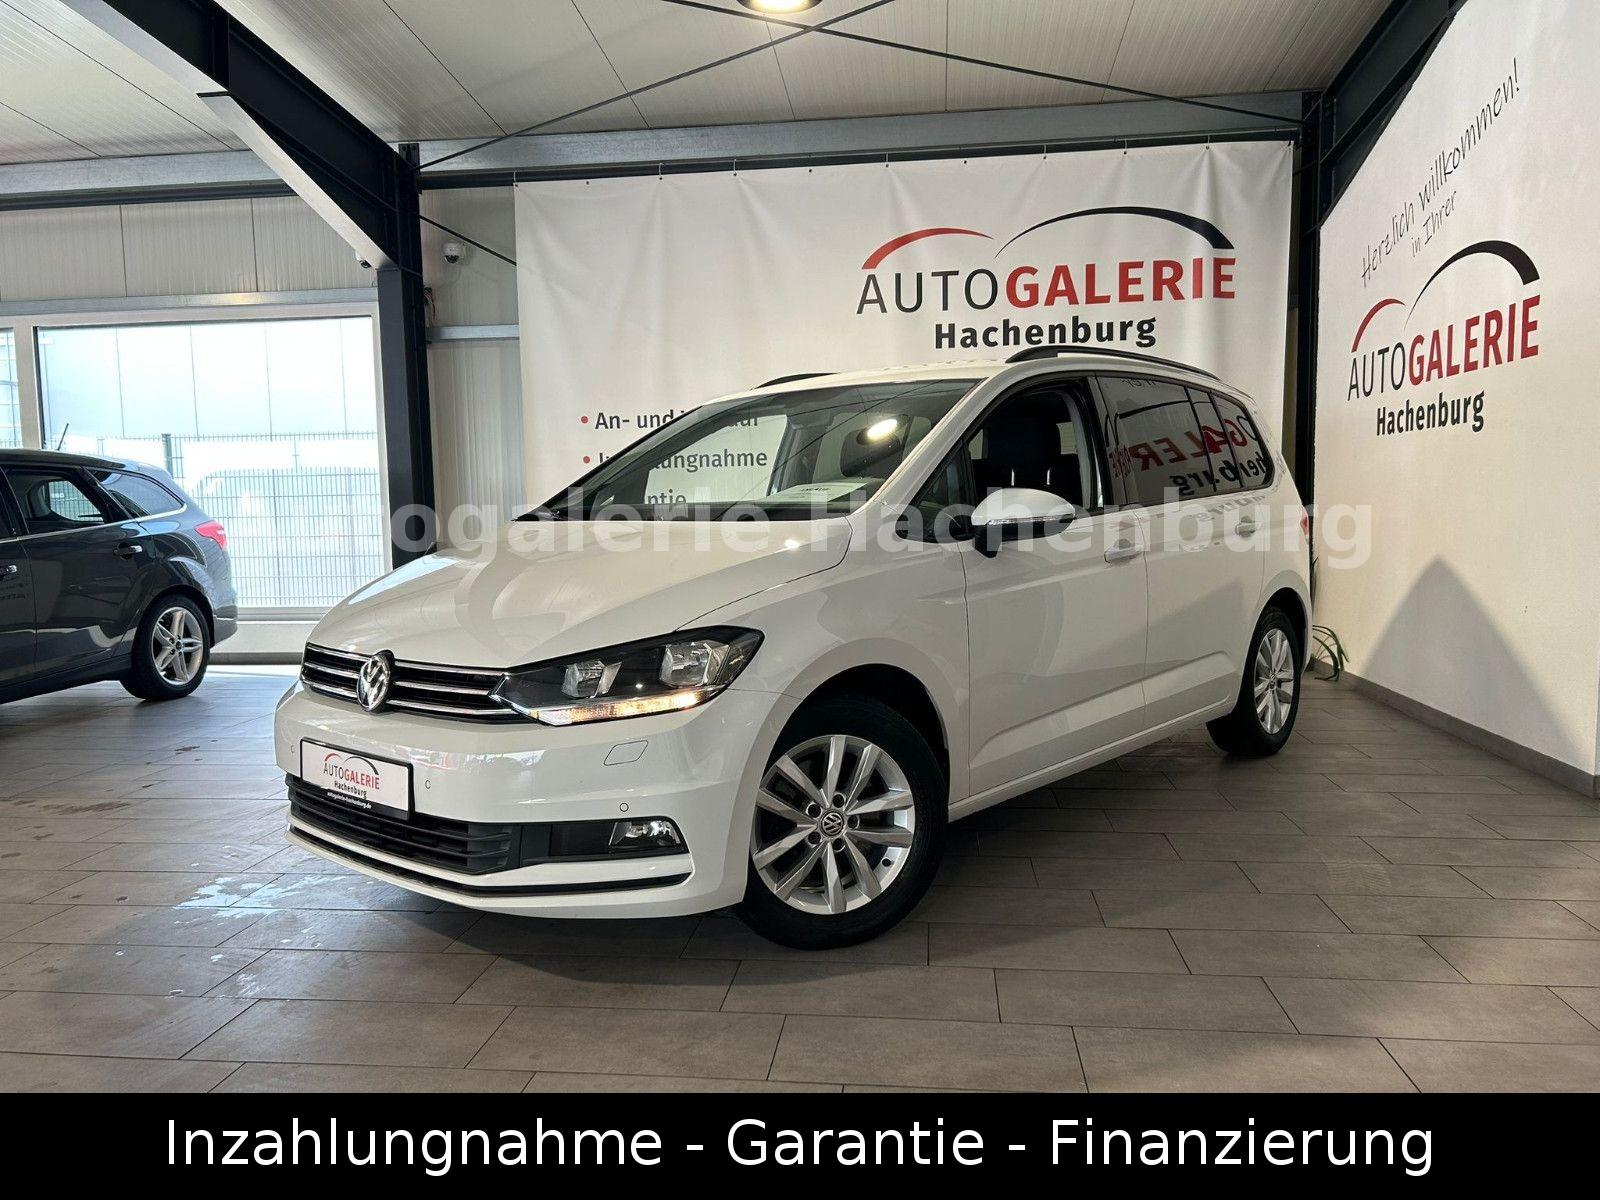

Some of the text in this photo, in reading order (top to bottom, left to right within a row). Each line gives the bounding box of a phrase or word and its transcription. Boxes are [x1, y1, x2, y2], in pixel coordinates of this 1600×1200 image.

[1362, 57, 1520, 287] Herzlich willkommen!
[1411, 190, 1457, 258] in Ihrer
[856, 257, 1236, 315] AUTOGALERIE
[935, 316, 1156, 349] Hachenburg
[1347, 294, 1540, 401] AUTOGALERIE
[595, 412, 629, 429] An-
[1376, 389, 1485, 436] Hachenburg
[323, 762, 380, 790] AUTOGALERIE
[334, 780, 367, 800] Hachenburg
